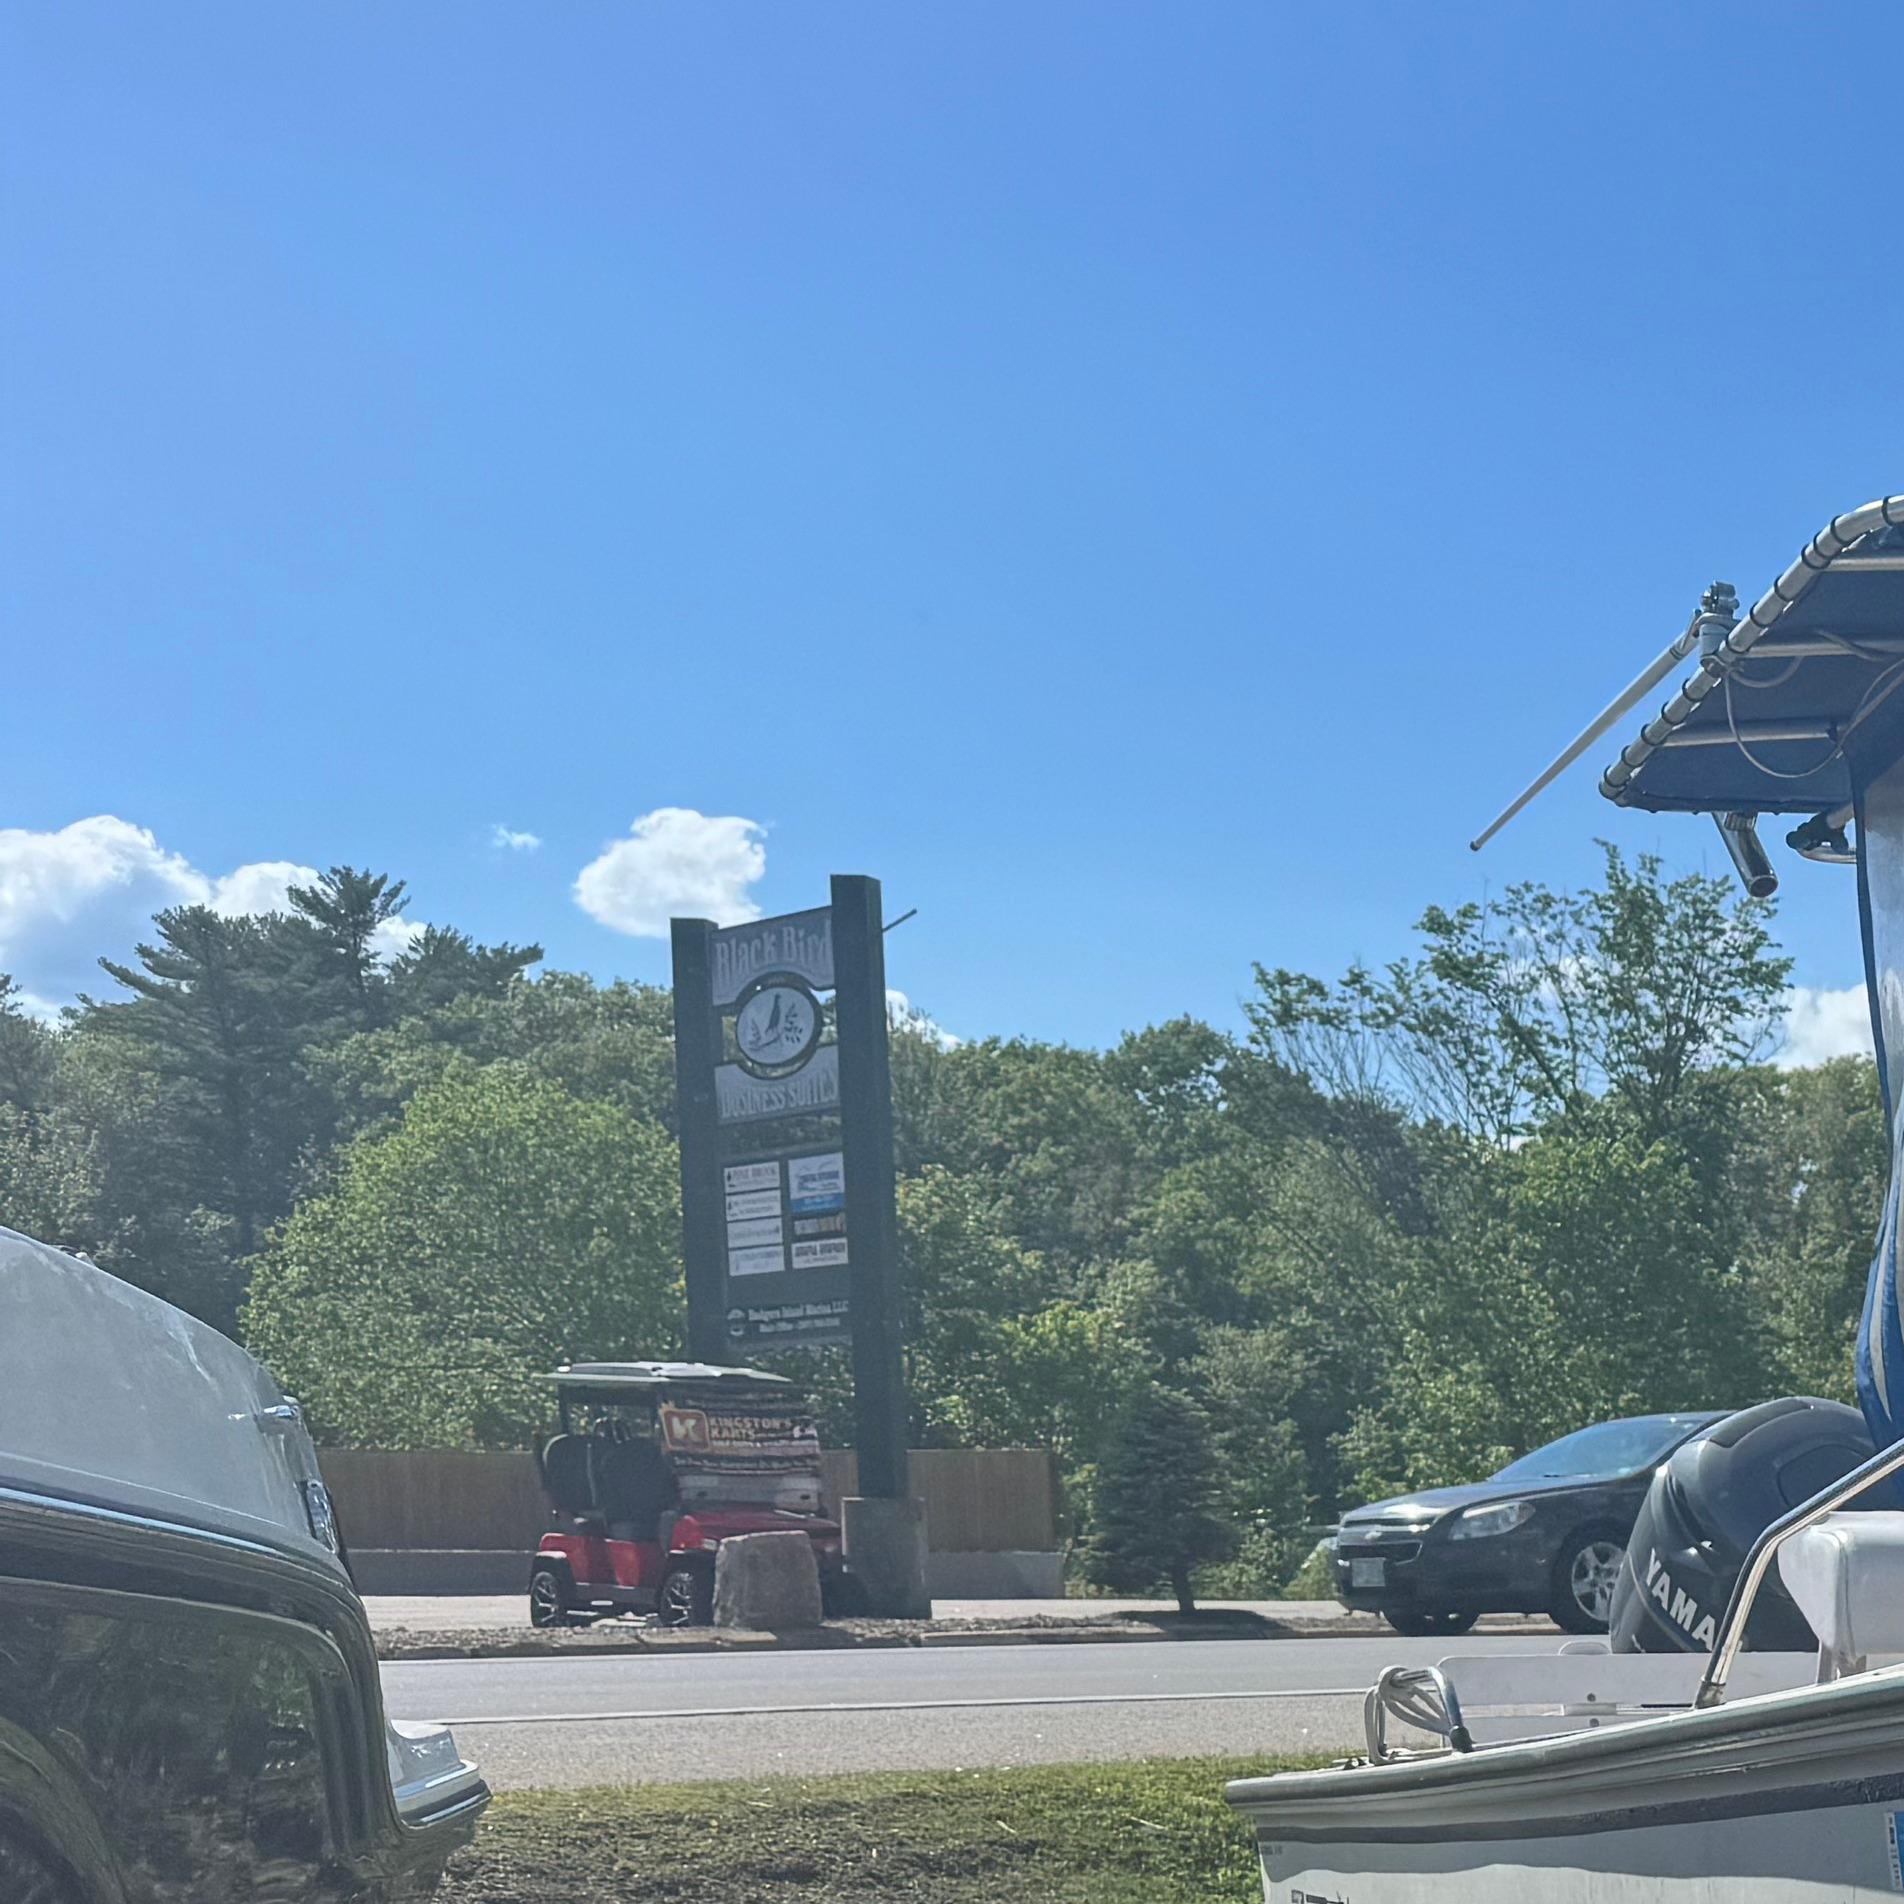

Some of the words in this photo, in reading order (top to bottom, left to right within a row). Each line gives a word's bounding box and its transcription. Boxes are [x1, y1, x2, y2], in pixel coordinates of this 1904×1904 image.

[716, 930, 777, 978] Black
[782, 917, 832, 962] Bird
[709, 1416, 792, 1429] KINGSTON'S
[710, 1427, 756, 1440] KARTS
[1646, 1547, 1716, 1651] YAMA
